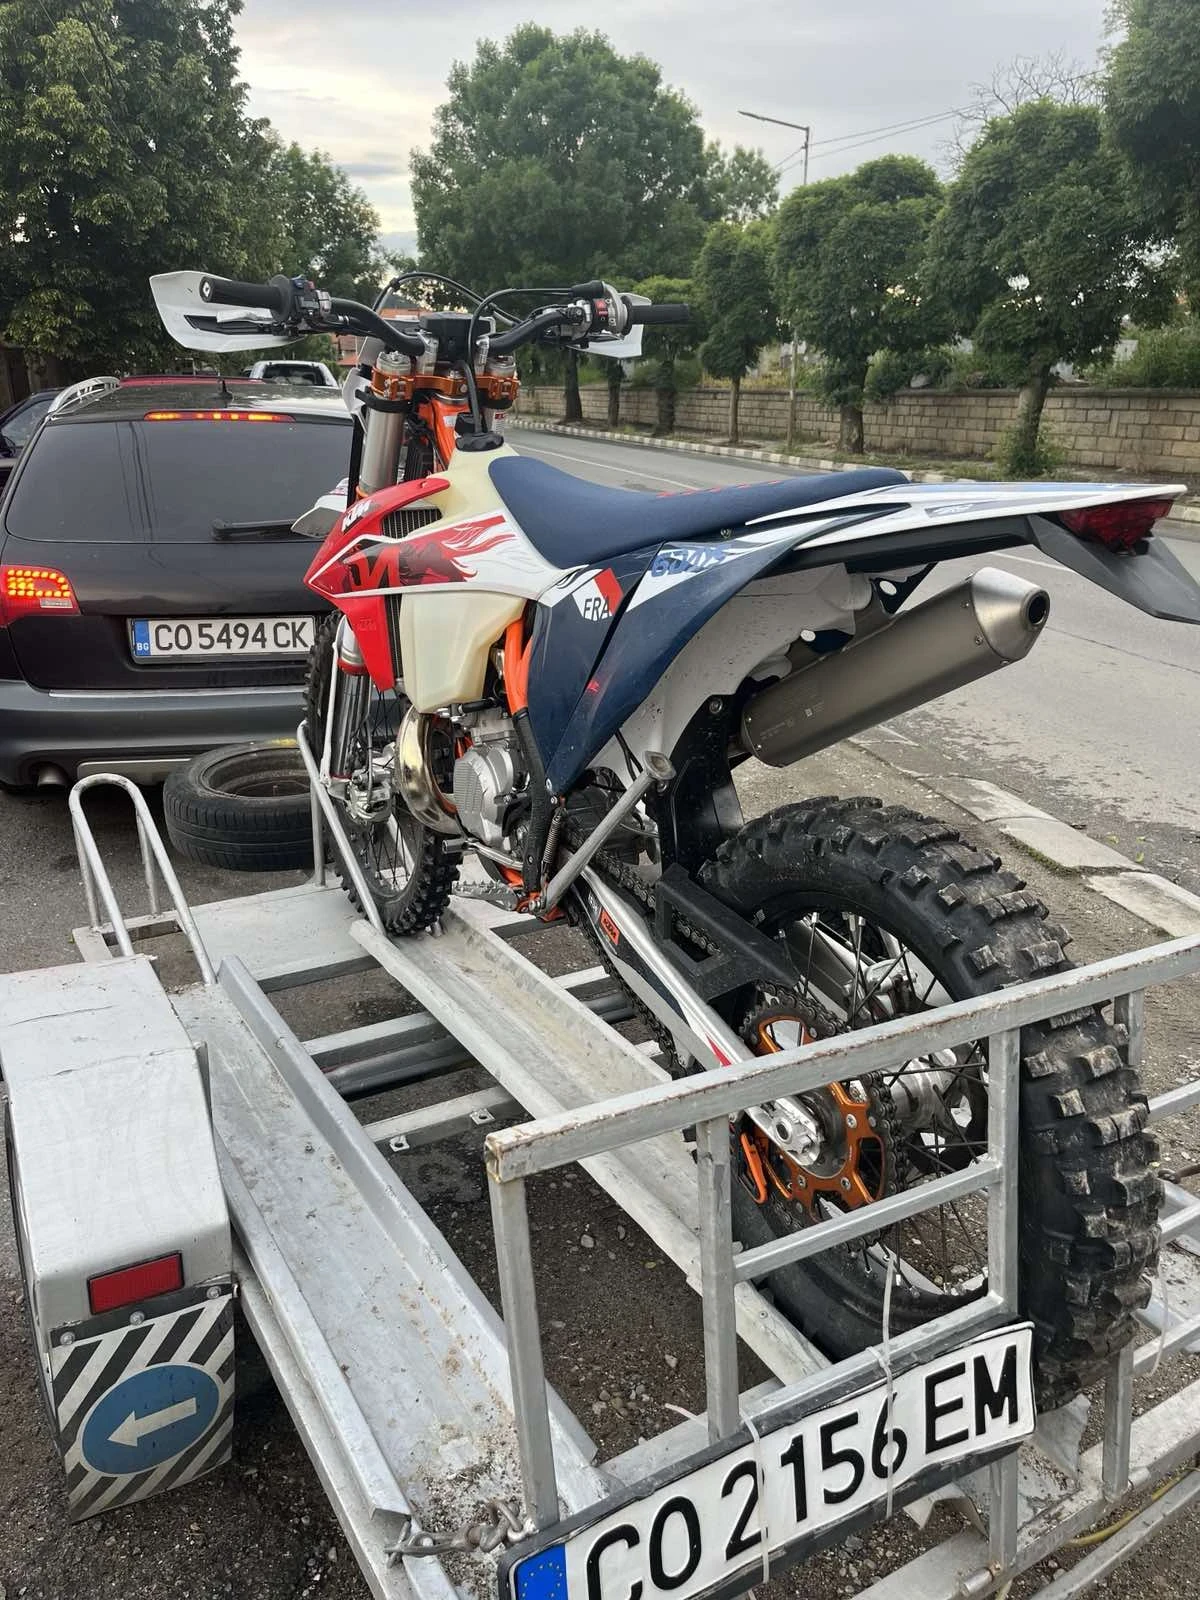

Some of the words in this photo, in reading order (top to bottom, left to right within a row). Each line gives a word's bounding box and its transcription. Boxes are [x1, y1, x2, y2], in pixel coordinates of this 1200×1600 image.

[341, 499, 374, 532] KTM
[583, 596, 610, 621] FRA
[136, 642, 149, 651] BG
[154, 624, 192, 651] CO
[198, 622, 267, 649] 5494
[273, 621, 309, 648] CK
[586, 1496, 701, 1600] CO
[721, 1391, 907, 1561] 2156
[924, 1344, 1019, 1454] EM
